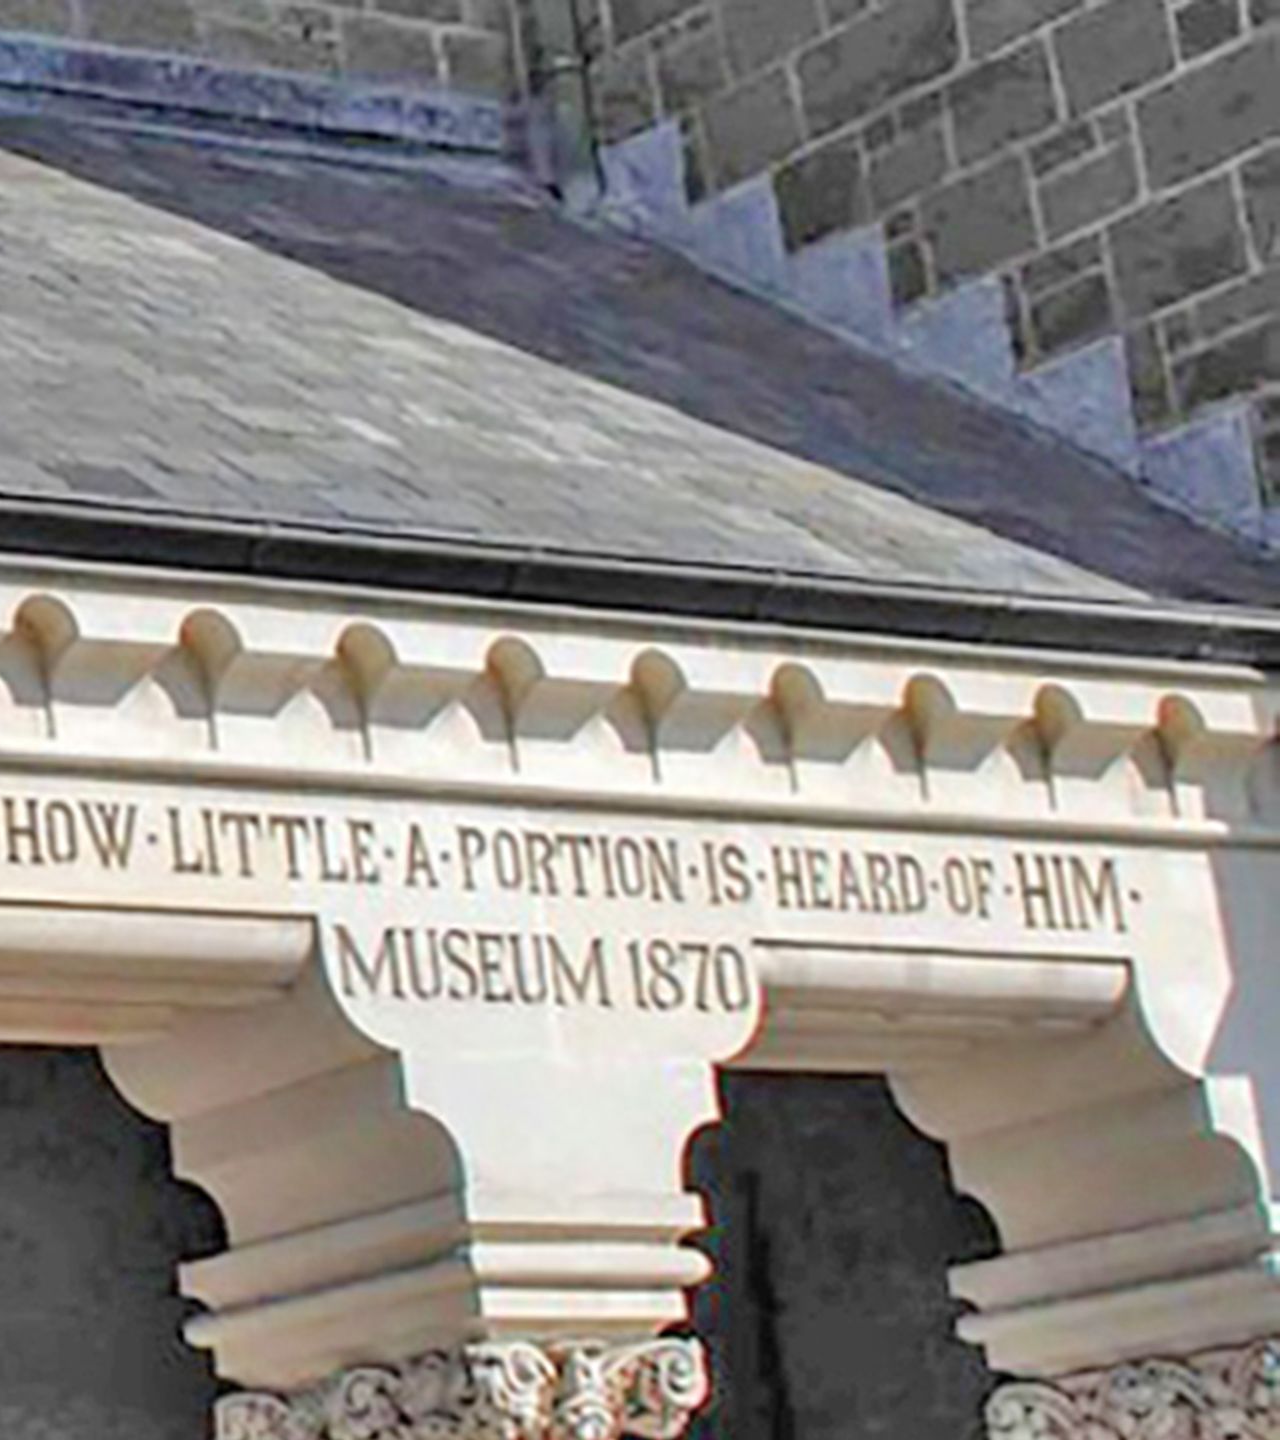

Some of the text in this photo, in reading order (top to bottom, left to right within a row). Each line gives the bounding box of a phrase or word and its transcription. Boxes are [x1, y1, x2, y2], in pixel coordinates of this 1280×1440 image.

[3, 799, 138, 868] HOW
[167, 808, 382, 884] LITTLE
[403, 823, 440, 890] A
[456, 825, 684, 904] PORTION
[700, 841, 752, 905] IS
[770, 846, 928, 915] HEARD
[944, 857, 994, 920] OF
[1013, 853, 1128, 934] HIM
[332, 923, 746, 1012] MUSEUM 1870
